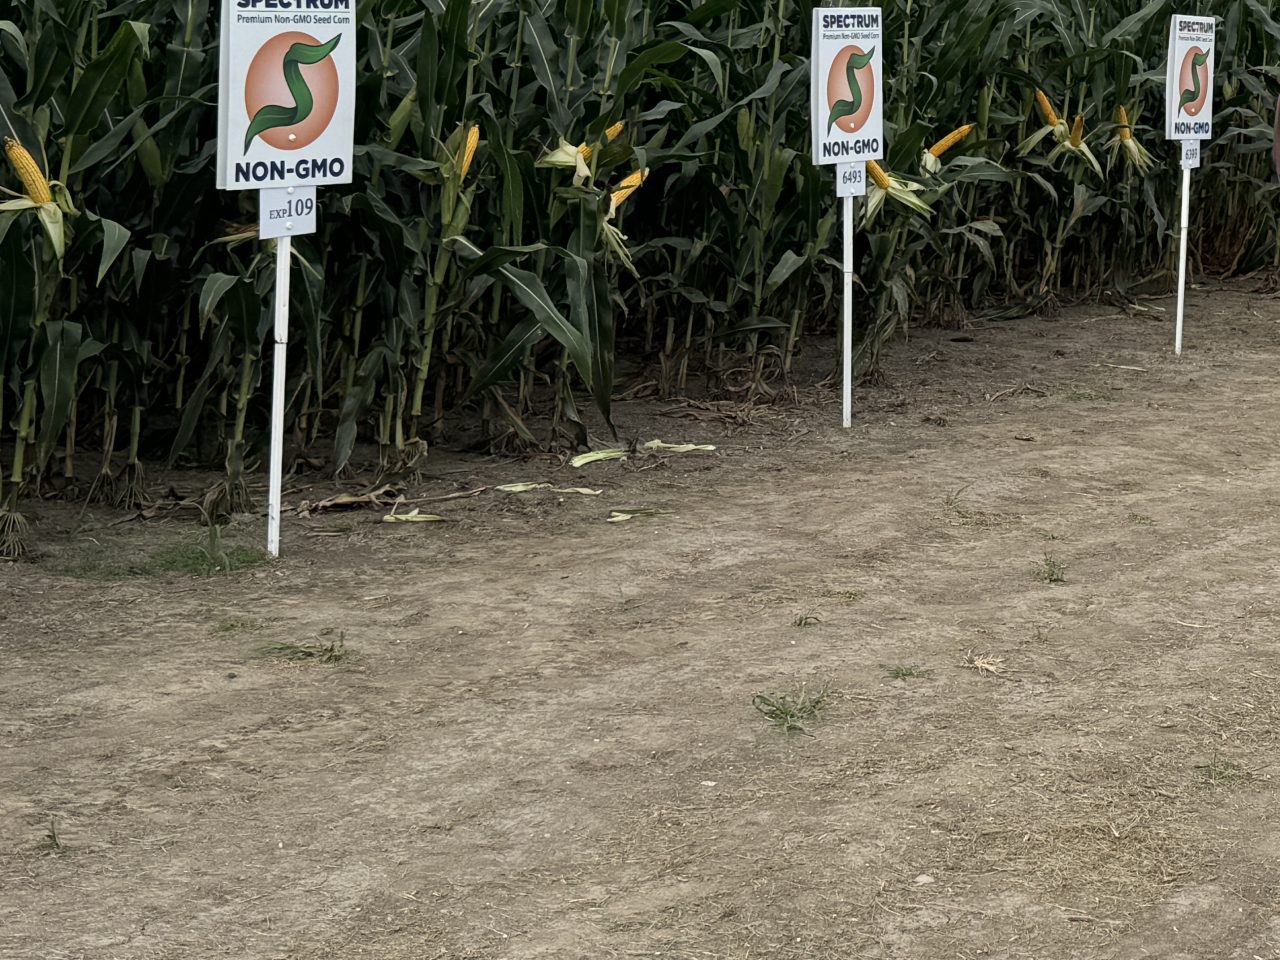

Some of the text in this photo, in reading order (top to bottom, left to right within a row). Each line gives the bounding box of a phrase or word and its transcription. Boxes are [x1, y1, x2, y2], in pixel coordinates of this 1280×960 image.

[237, 14, 350, 24] Premium Non-GMO Seed Corn
[822, 14, 879, 28] SPECTRUM
[1178, 20, 1213, 34] SPECTRUM
[1174, 122, 1210, 135] NON-GMO
[822, 138, 879, 158] NON-GMO
[234, 157, 345, 183] NON-GMO
[842, 170, 862, 185] 6493
